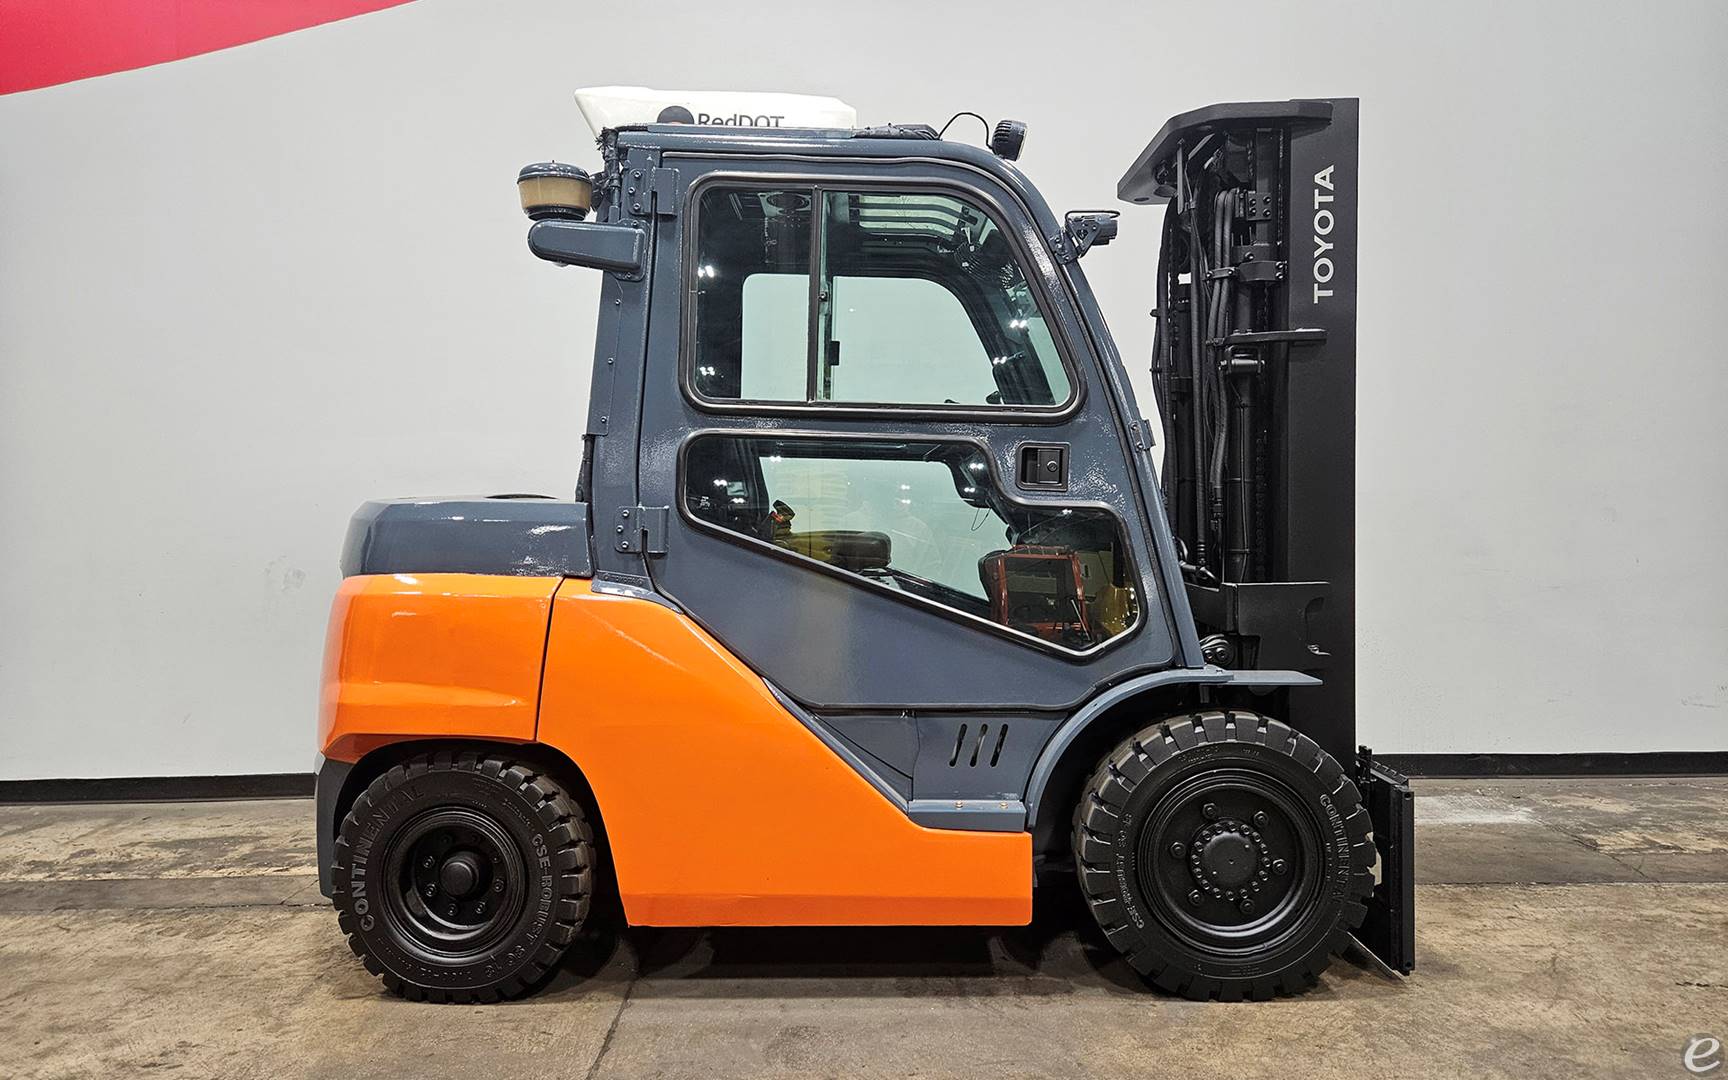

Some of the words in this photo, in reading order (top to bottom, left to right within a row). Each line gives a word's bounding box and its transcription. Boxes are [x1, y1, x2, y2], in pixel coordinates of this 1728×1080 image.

[698, 113, 785, 127] RedDOT
[1313, 164, 1335, 305] TOYOTA
[1319, 794, 1350, 902] CONTINNTA
